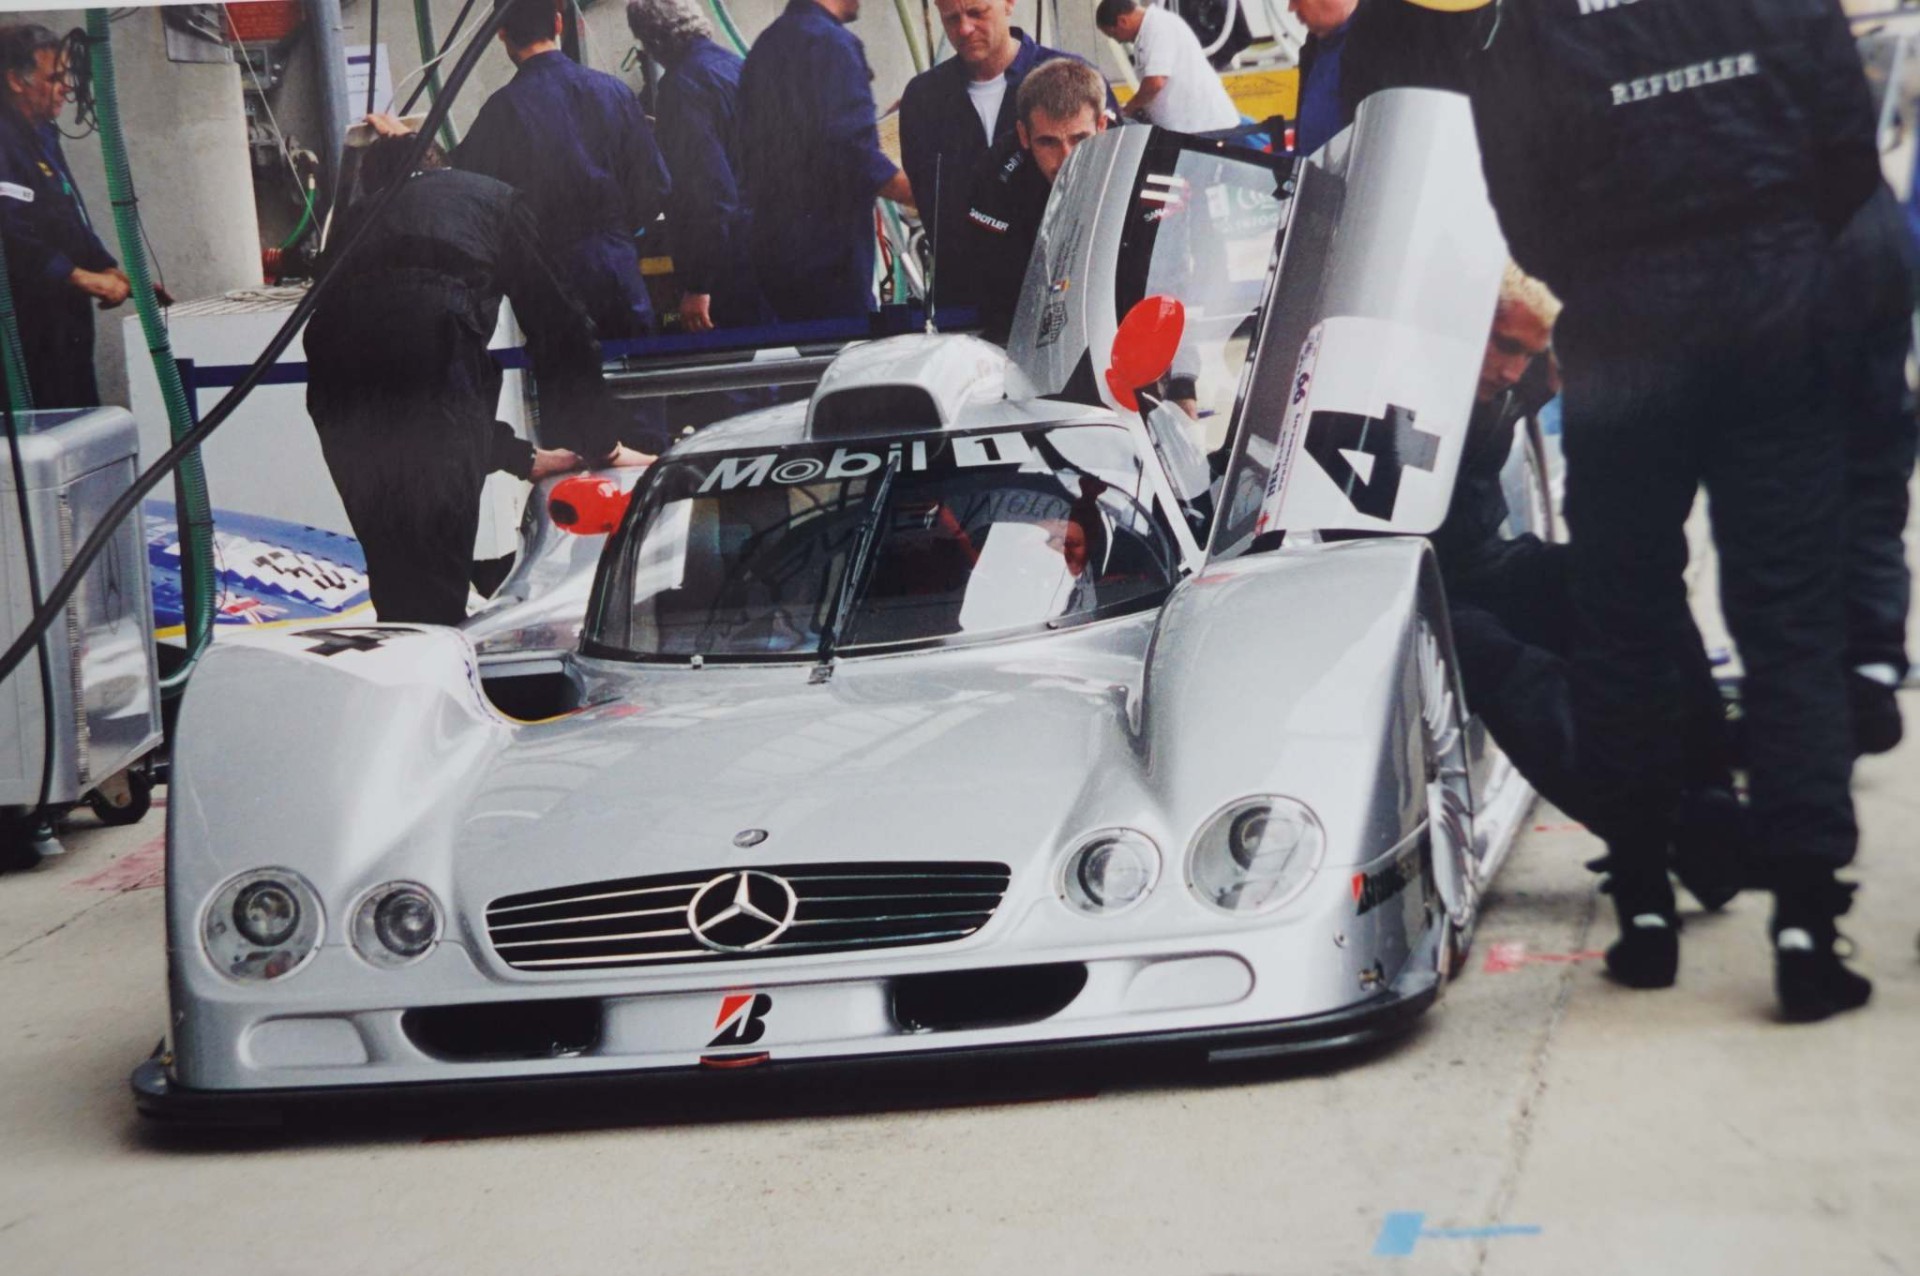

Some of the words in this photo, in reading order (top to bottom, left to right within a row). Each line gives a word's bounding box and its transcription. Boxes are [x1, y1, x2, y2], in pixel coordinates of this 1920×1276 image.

[1610, 53, 1758, 105] REFUELER
[697, 441, 928, 493] Mobil
[1304, 403, 1441, 521] 4
